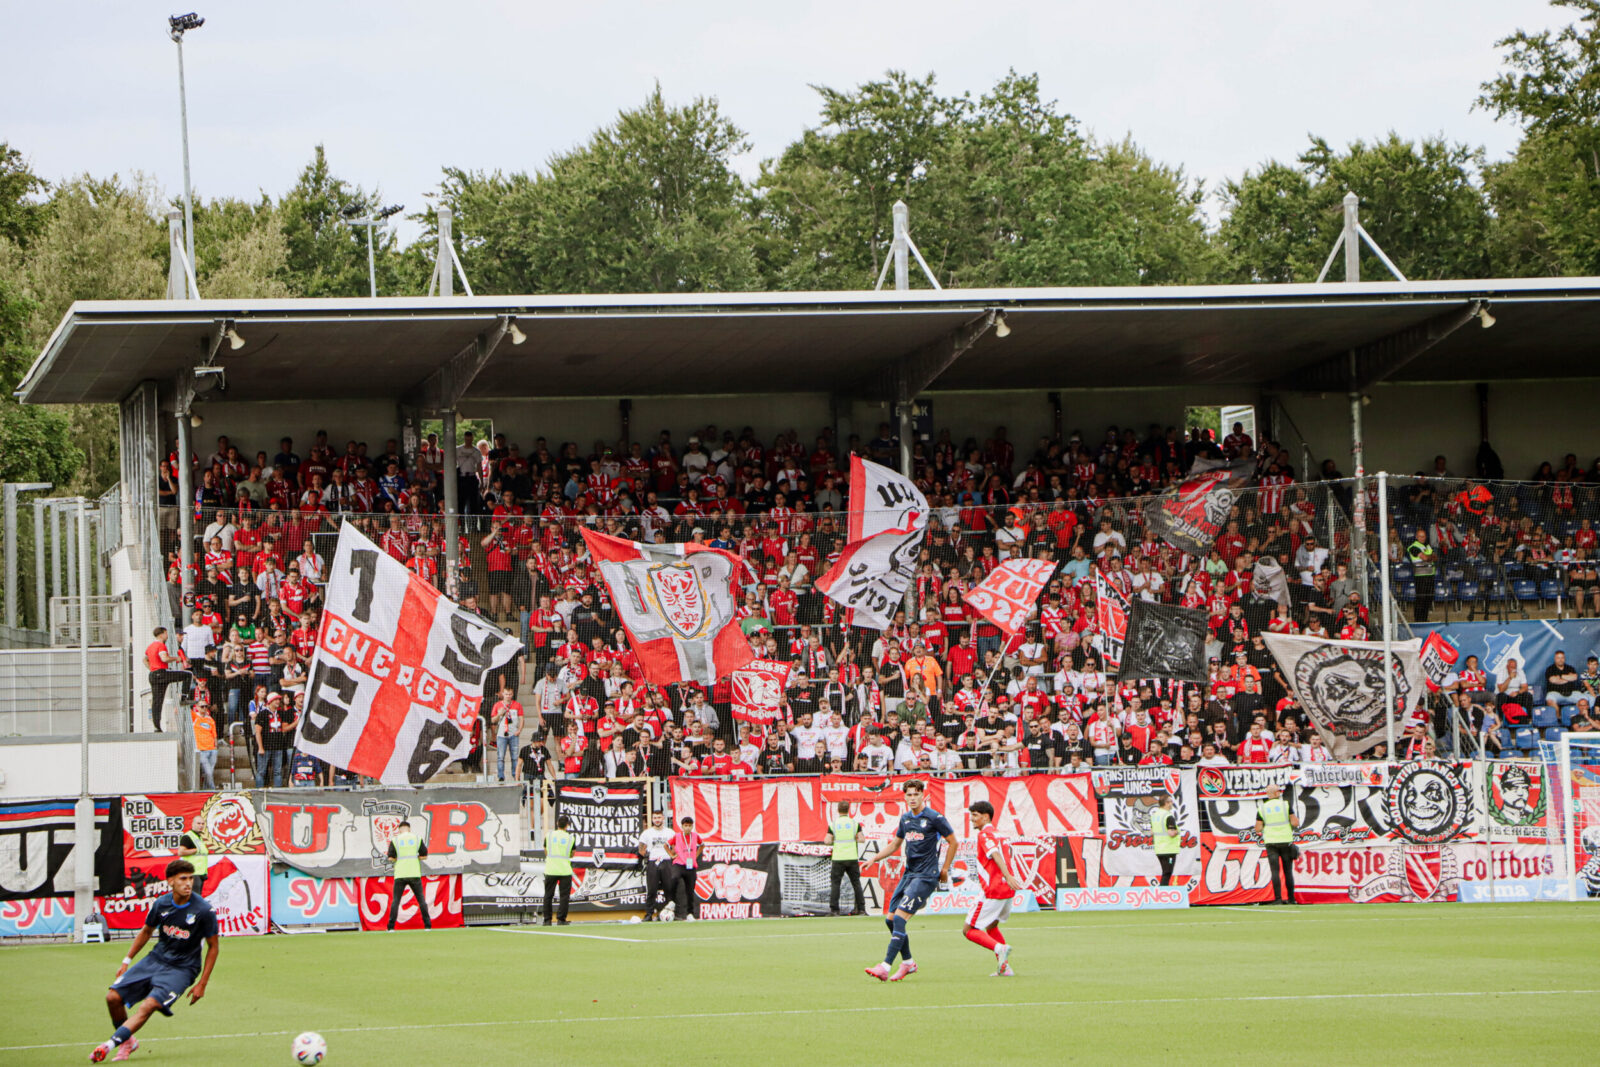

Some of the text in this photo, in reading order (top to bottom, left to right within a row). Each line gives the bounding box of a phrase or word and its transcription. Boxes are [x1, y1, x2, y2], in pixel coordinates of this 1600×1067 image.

[325, 621, 477, 726] ENERGIE
[821, 783, 860, 792] ELSTER
[1122, 781, 1152, 794] JUNGS
[125, 800, 154, 817] RED
[559, 802, 640, 817] PSEUDOFANS
[131, 816, 185, 833] EAGLES
[562, 815, 640, 833] NERGIE
[134, 834, 181, 851] COTTB
[574, 832, 640, 848] OTTBUS
[702, 845, 761, 864] SPORTSTADT
[620, 895, 647, 905] HOTE
[901, 895, 914, 910] 24
[1063, 887, 1183, 911] syNeo syNeo
[700, 903, 751, 920] FRANKFURT
[163, 991, 177, 1006] 7
